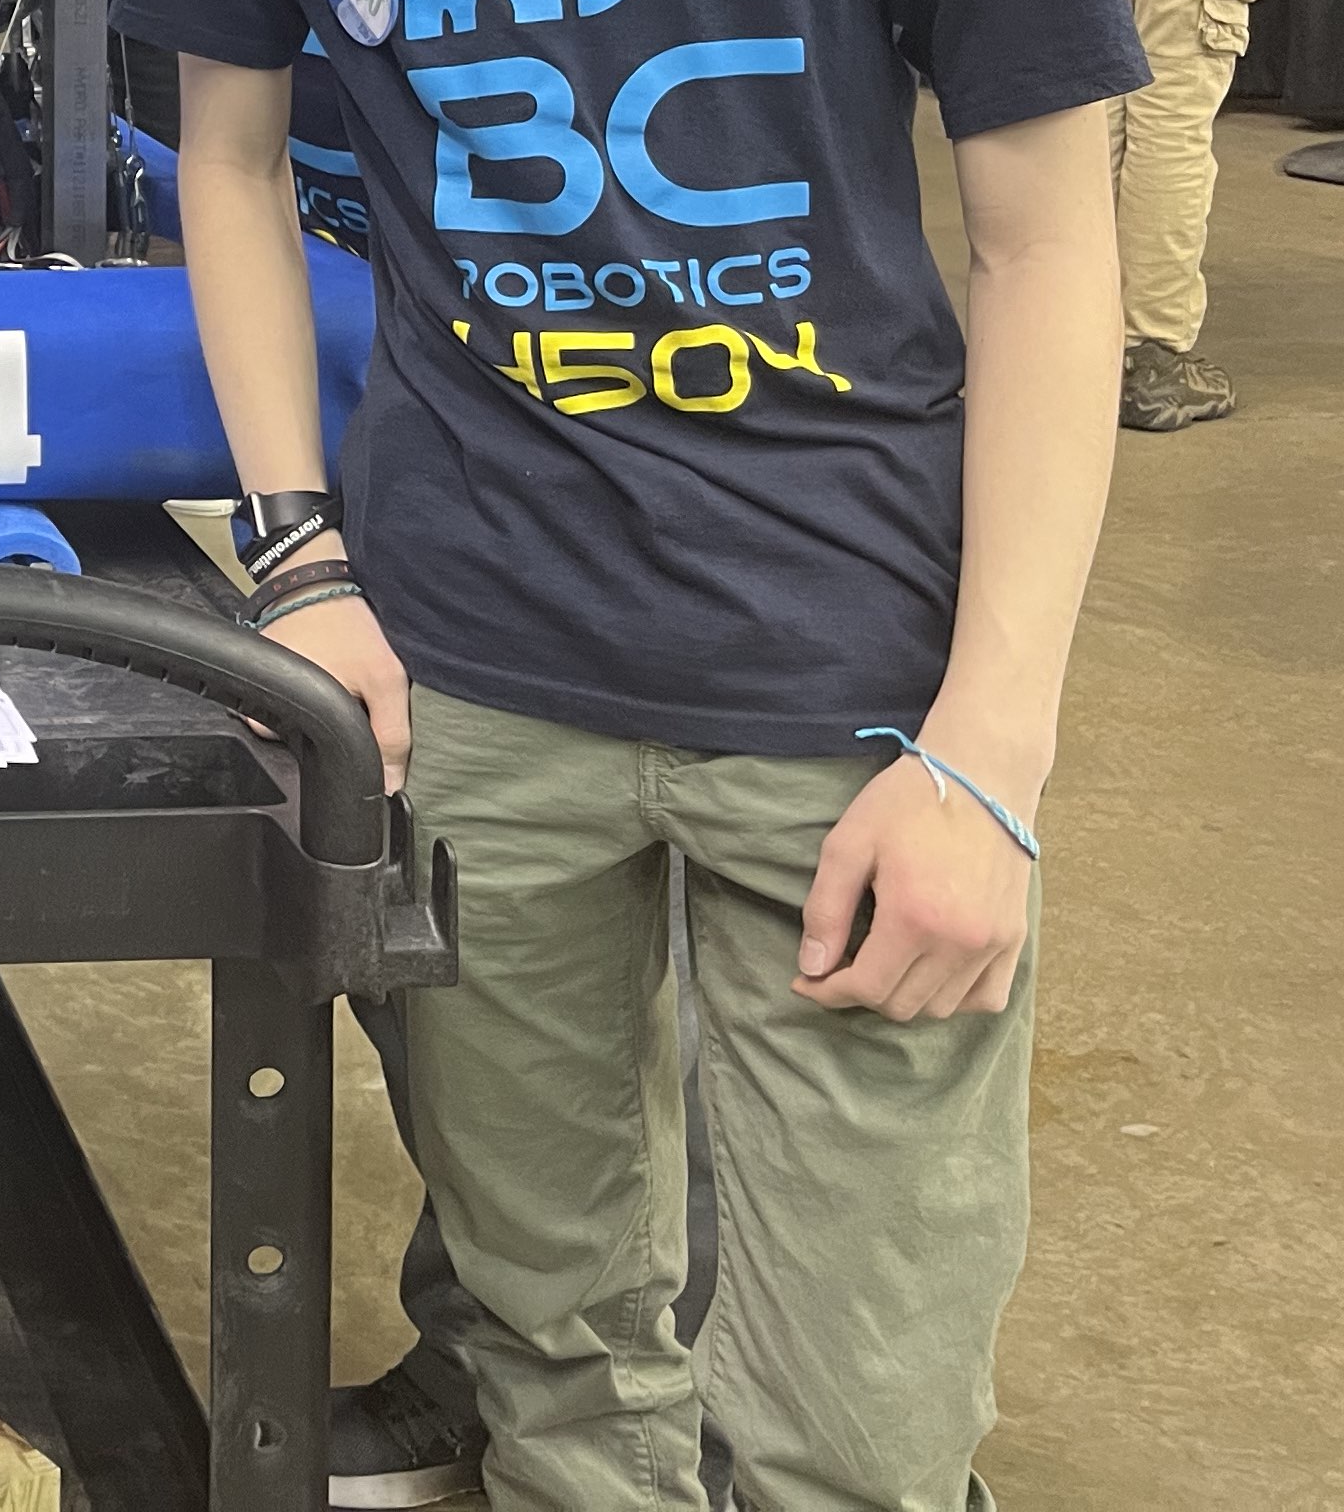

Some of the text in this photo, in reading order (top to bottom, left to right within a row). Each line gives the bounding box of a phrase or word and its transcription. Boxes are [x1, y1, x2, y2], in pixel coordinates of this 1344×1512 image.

[406, 36, 812, 236] BC
[454, 246, 813, 312] ROBOTICS
[450, 319, 853, 416] 4504
